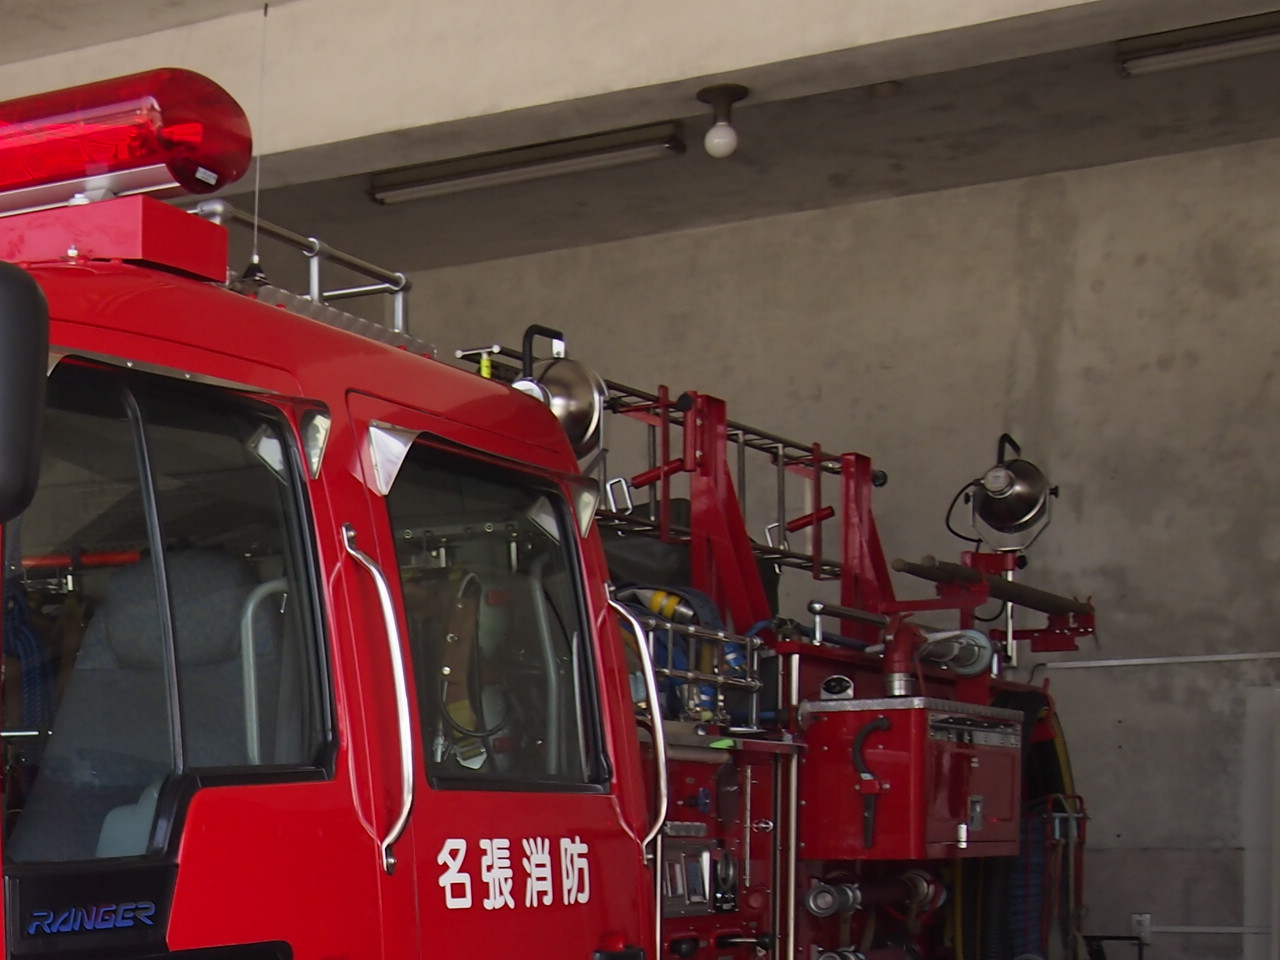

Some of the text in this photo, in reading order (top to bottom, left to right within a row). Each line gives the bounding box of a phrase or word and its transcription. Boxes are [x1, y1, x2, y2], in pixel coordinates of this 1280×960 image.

[437, 835, 591, 910] 名張消防
[28, 901, 156, 935] RANGER
